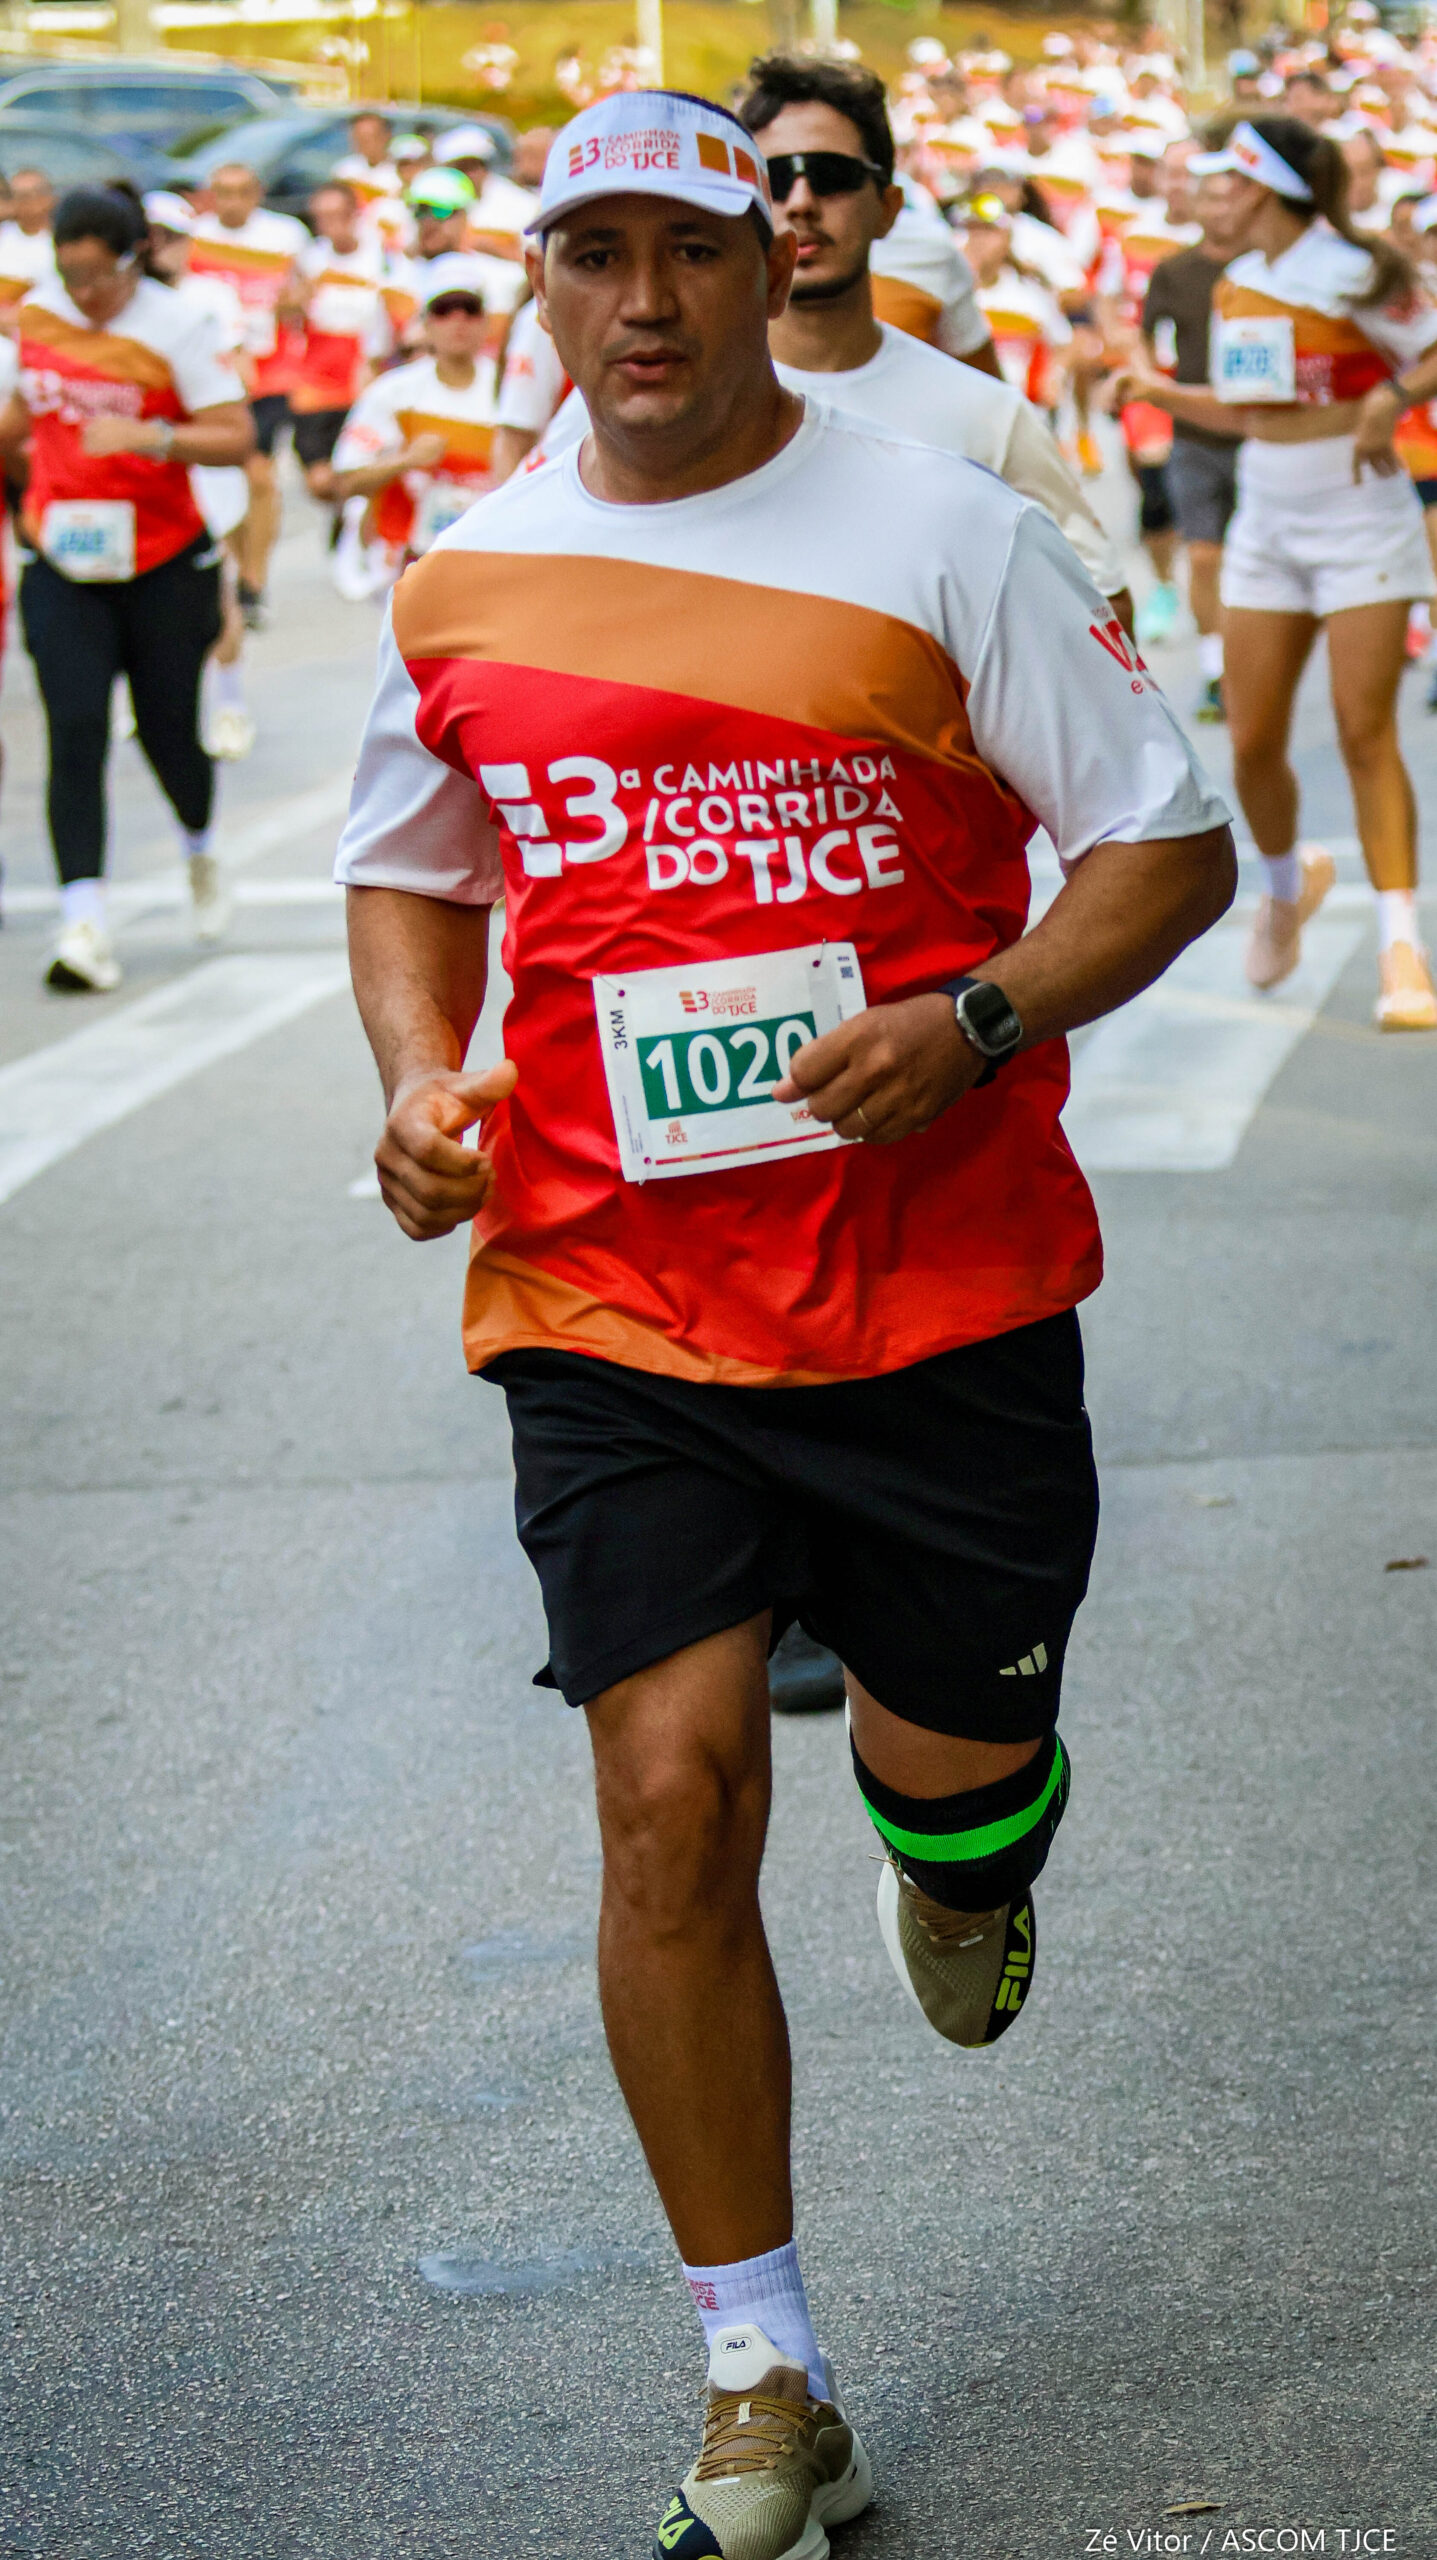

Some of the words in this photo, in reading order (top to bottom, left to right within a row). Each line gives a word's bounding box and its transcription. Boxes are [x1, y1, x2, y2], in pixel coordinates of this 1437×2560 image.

[605, 154, 628, 170] DO
[630, 152, 680, 170] TJCE
[653, 755, 897, 795] CAMINHADA
[645, 839, 729, 891] DO
[735, 824, 905, 904] TJCE
[609, 1008, 628, 1050] 3KM
[728, 1002, 757, 1016] TJCE
[995, 1904, 1031, 2012] FILA
[726, 2340, 746, 2350] FILA
